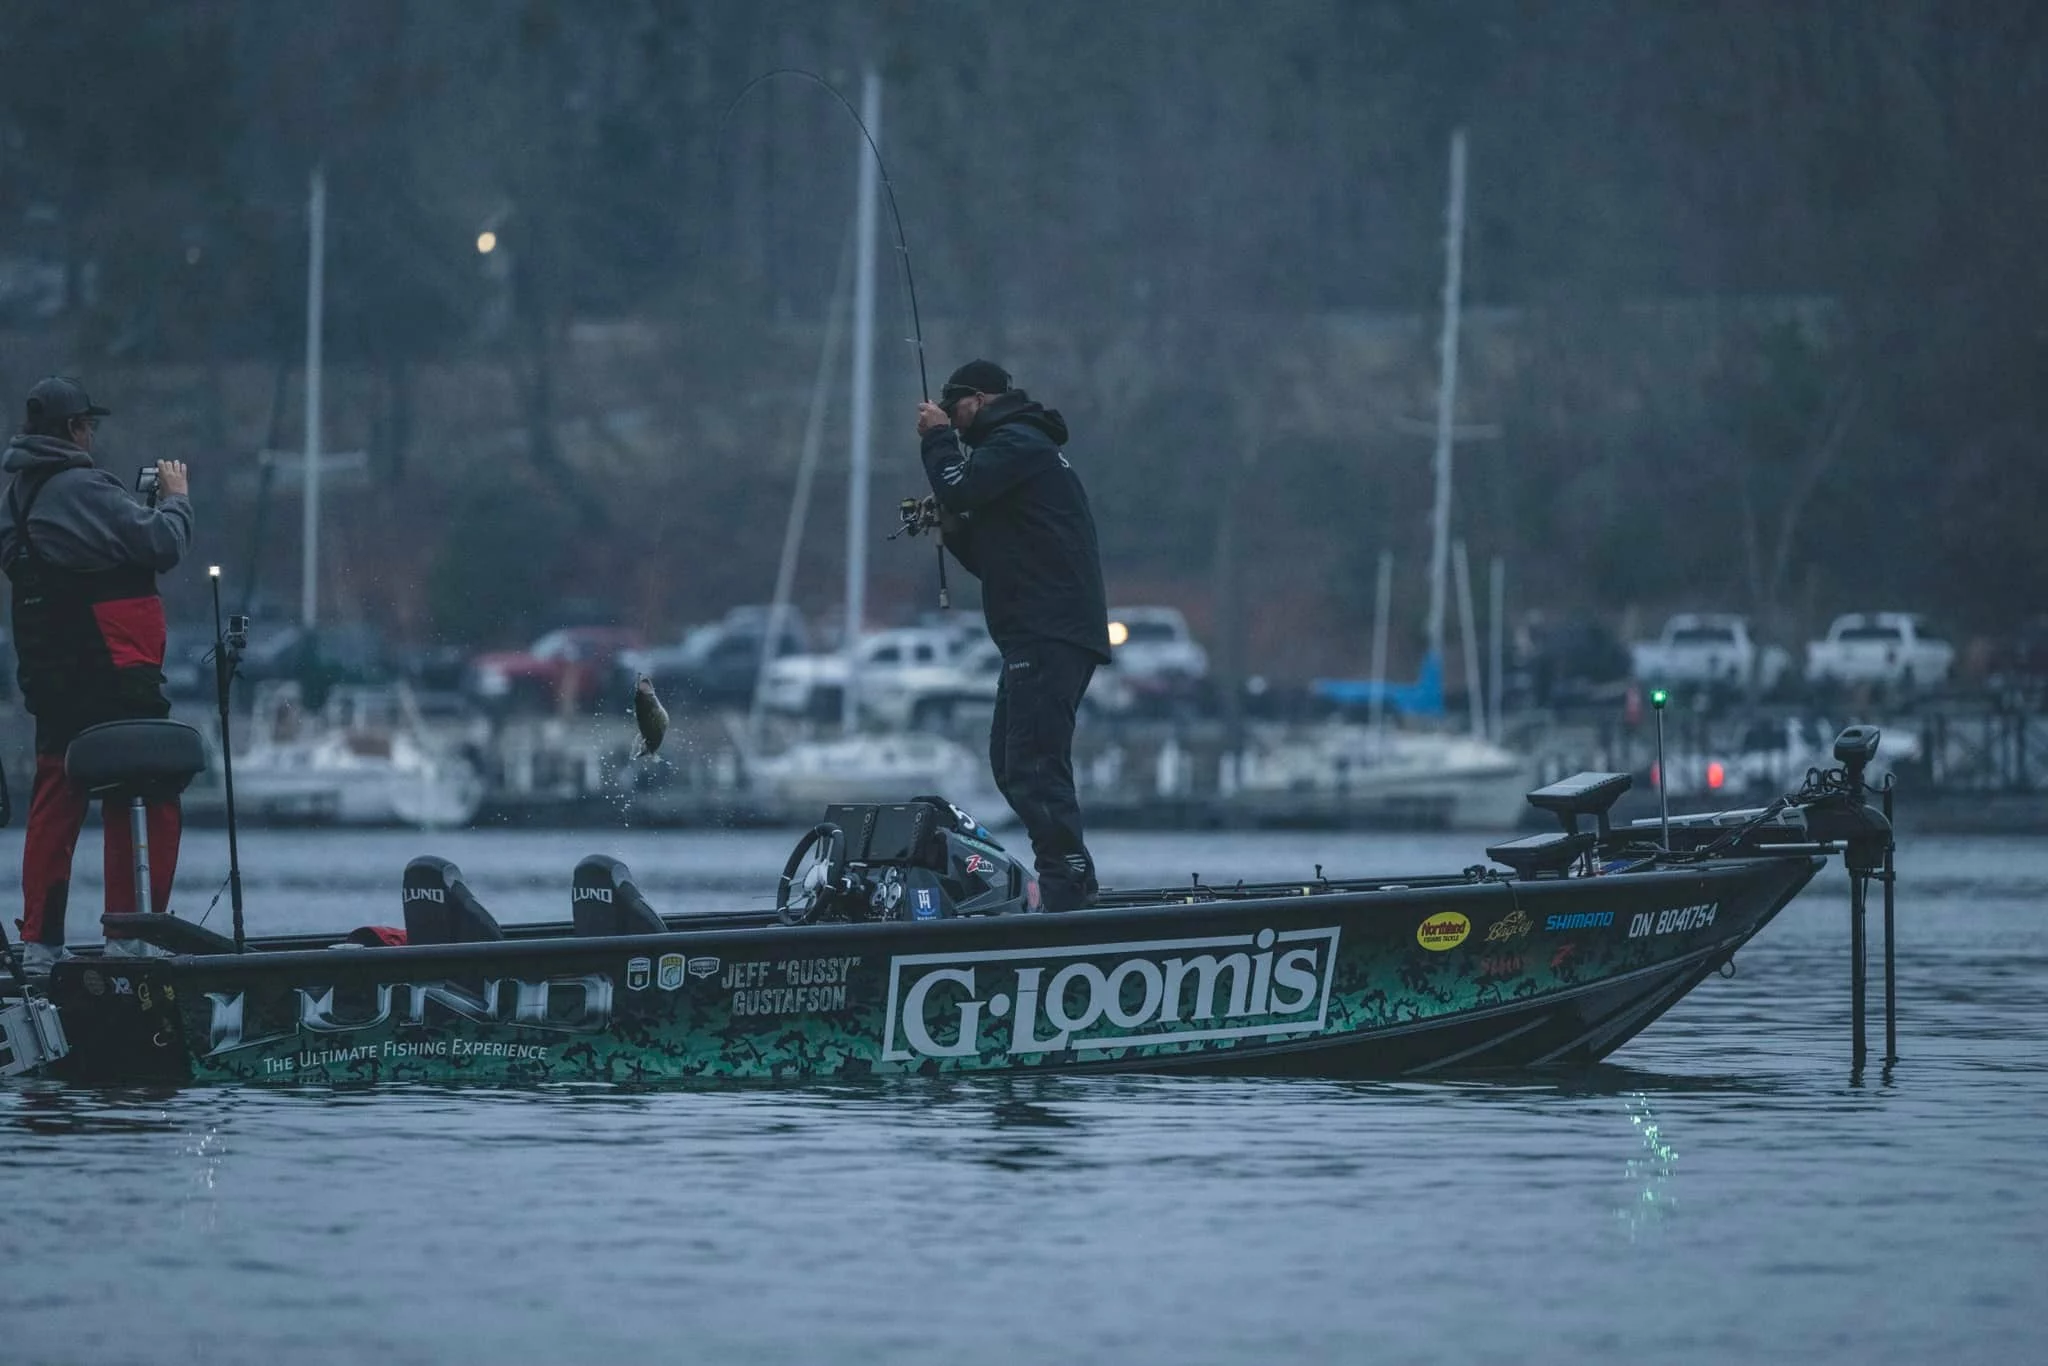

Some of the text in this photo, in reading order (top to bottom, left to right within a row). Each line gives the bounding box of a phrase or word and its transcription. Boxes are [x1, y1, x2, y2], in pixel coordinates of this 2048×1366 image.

[403, 887, 446, 904] LUND
[572, 887, 614, 904] LUND
[1544, 911, 1616, 932] SHIMANO
[1628, 902, 1719, 938] ON 8041754
[721, 961, 771, 989] JEFF
[776, 956, 862, 986] "GUSSY"
[203, 973, 614, 1057] LUND
[732, 985, 848, 1017] GUSTAFSON
[263, 1038, 548, 1075] THE ULTIMATE FISHING EXPERIENCE
